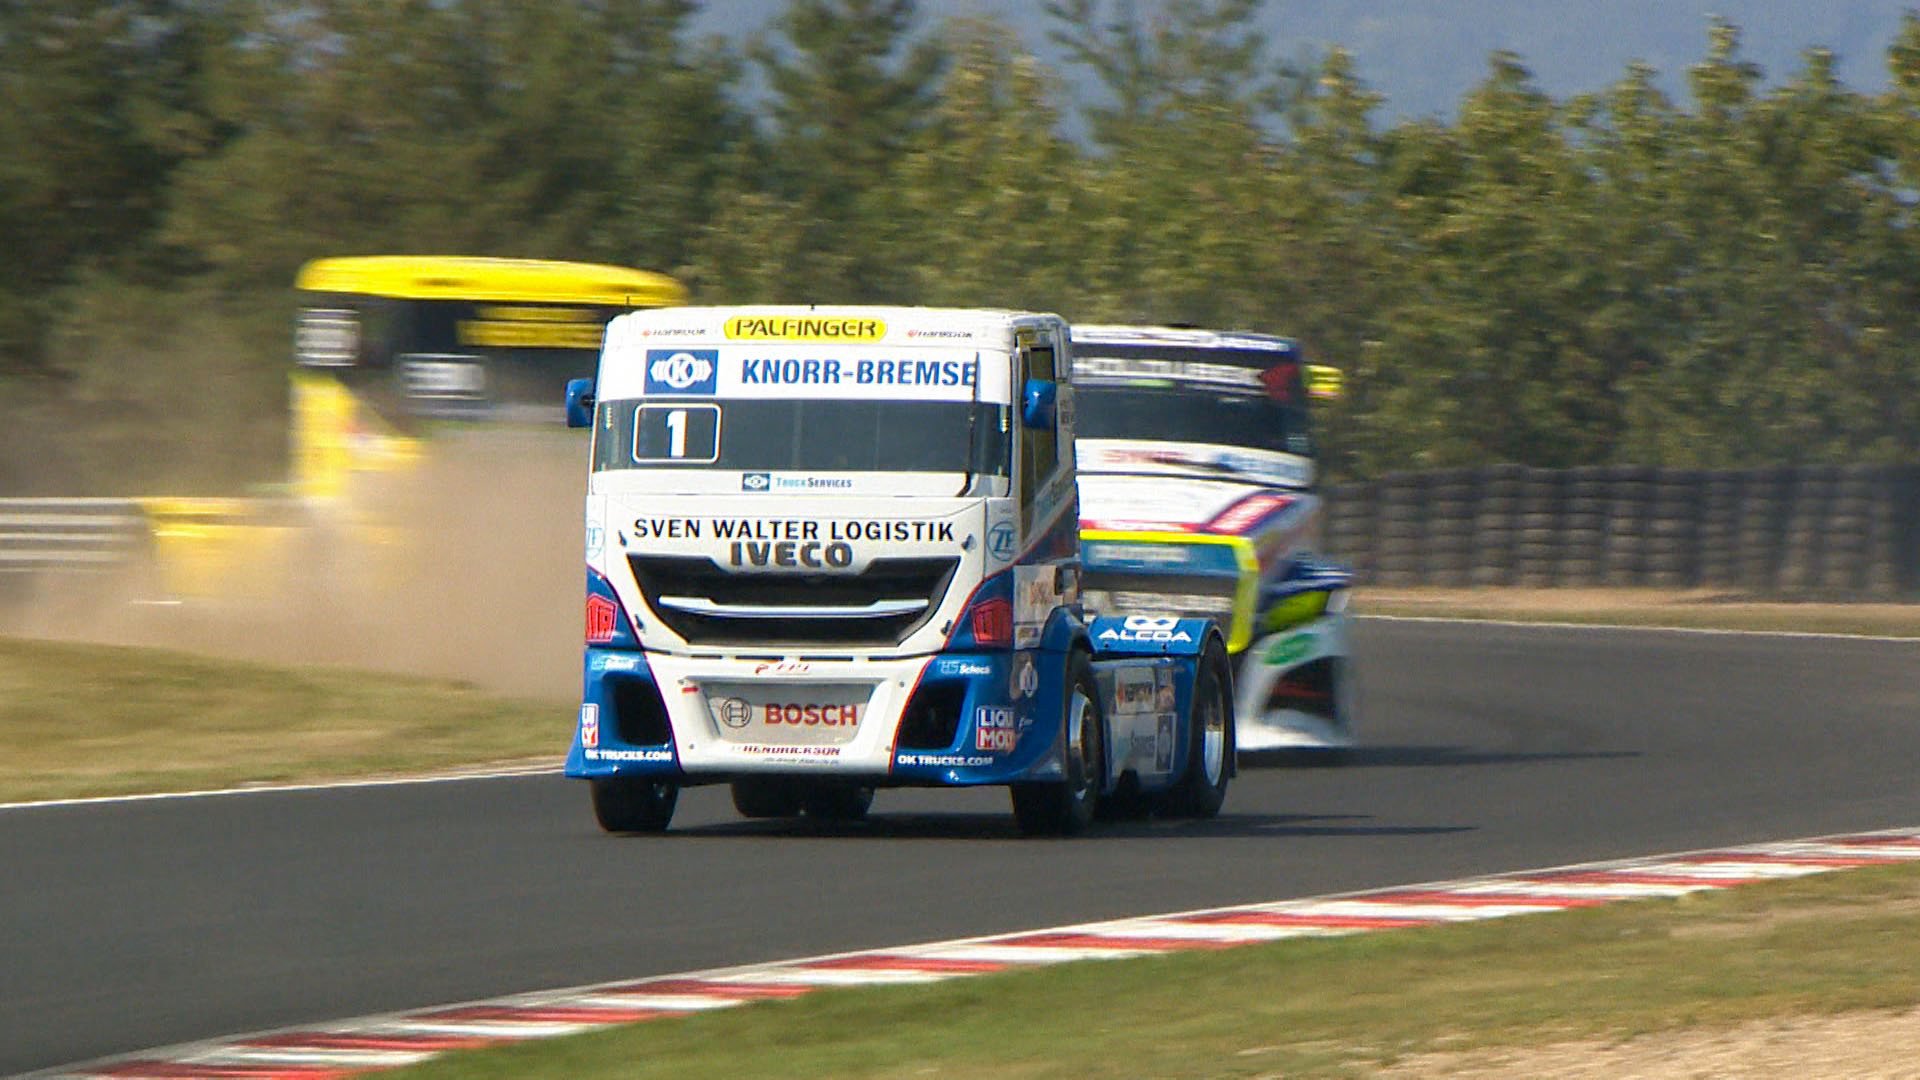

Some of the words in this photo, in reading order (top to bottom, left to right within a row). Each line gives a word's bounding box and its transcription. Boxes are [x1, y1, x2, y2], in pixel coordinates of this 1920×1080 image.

[735, 318, 877, 337] PALFINGER
[741, 358, 977, 387] KNORR-BREMSE
[666, 410, 688, 458] 1
[634, 518, 701, 538] SVEN
[713, 519, 818, 540] WALTER
[831, 521, 955, 542] LOGISTIK
[730, 541, 853, 568] IVECO
[1098, 628, 1193, 643] ALCOA
[764, 703, 858, 727] BOSCH
